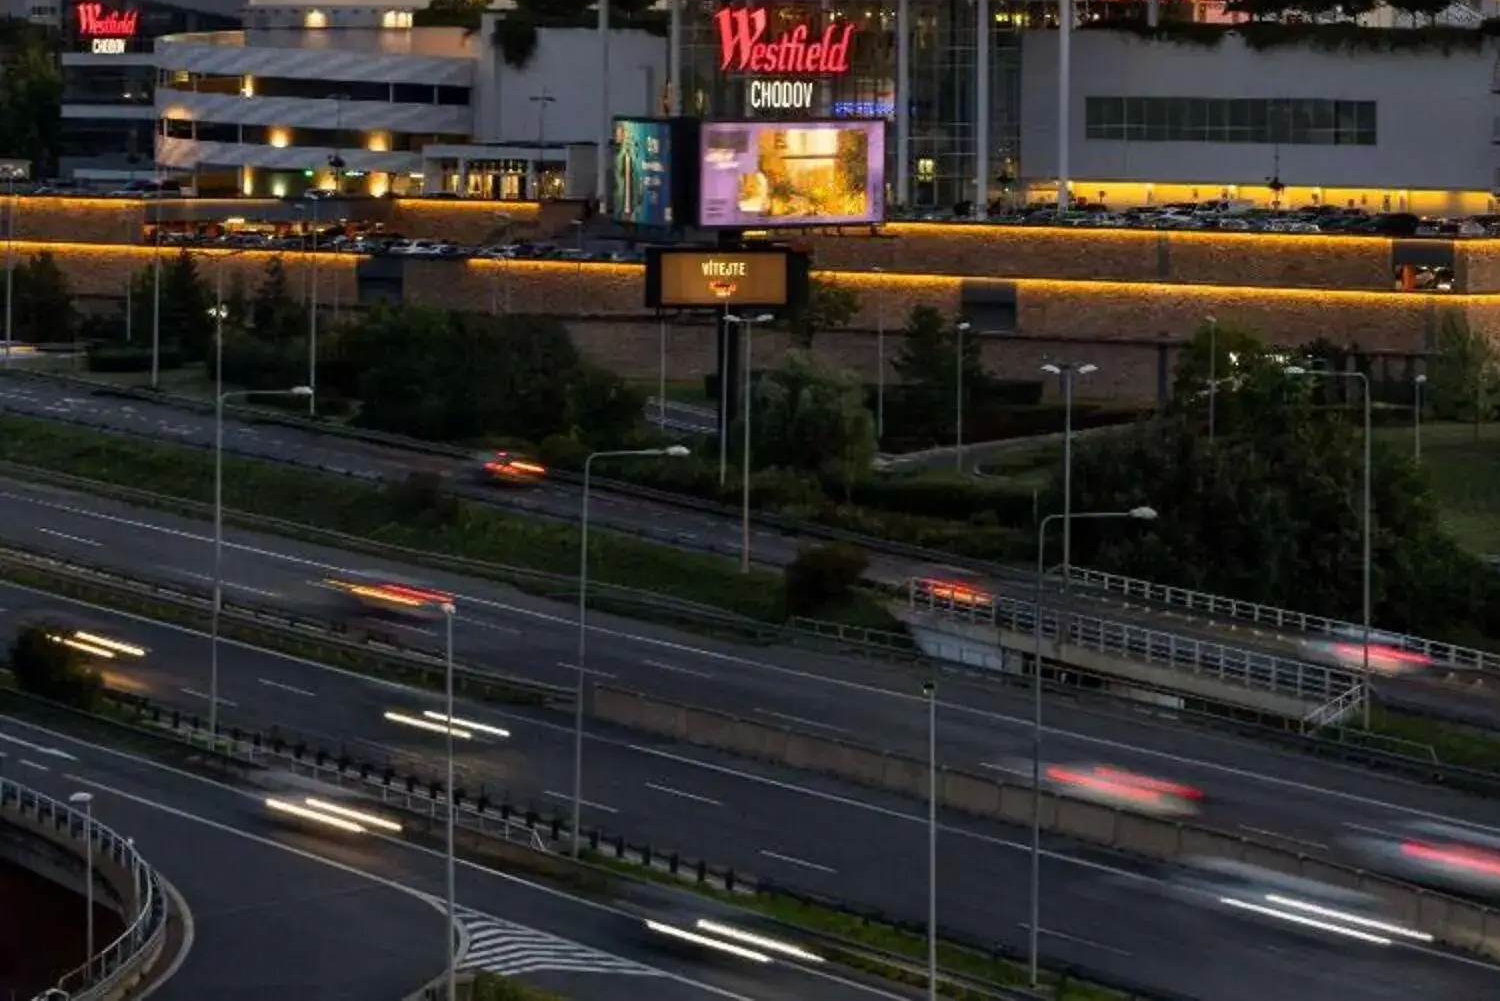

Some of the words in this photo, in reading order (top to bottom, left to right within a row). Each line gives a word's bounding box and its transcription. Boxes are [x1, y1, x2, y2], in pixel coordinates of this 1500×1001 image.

[715, 7, 855, 73] Westfield
[751, 80, 813, 108] CHODOV
[701, 260, 746, 276] VÍTEJTE
